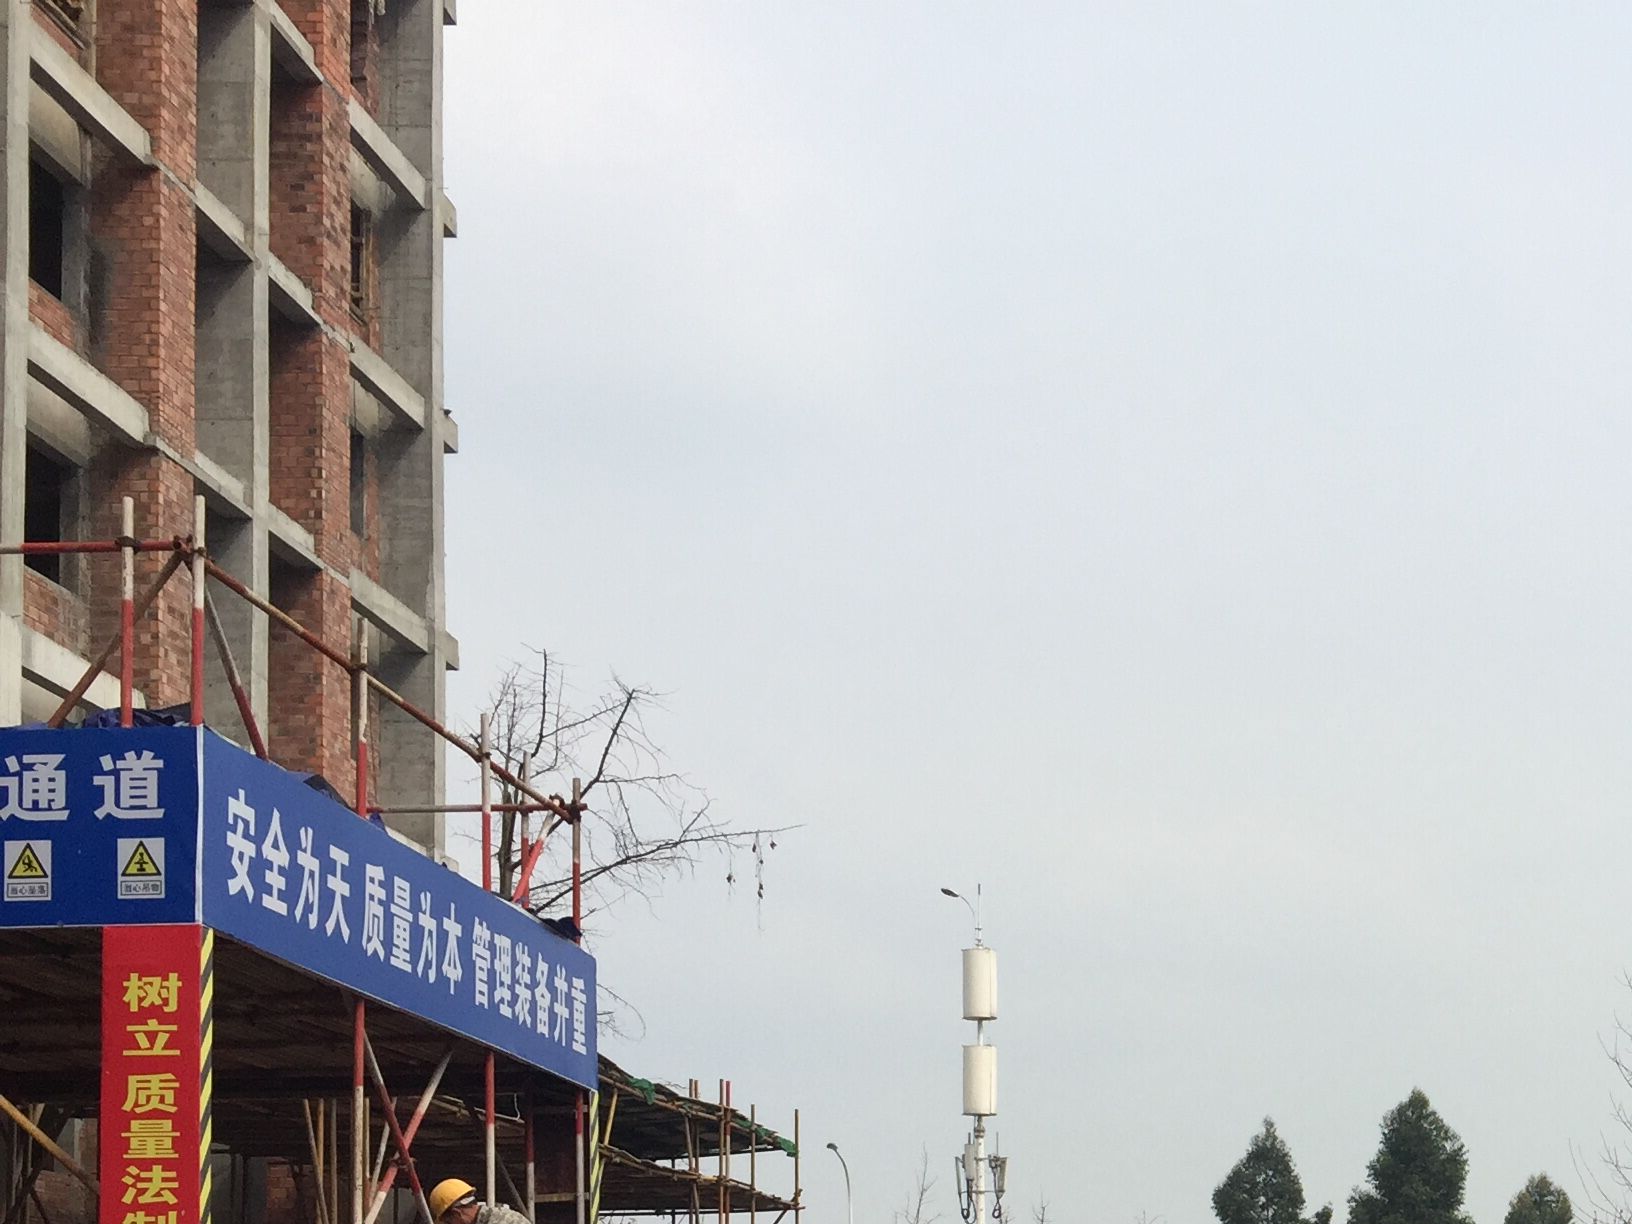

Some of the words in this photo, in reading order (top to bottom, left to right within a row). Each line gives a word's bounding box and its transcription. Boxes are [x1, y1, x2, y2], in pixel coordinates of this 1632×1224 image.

[0, 750, 166, 821] 通道
[226, 788, 350, 945] 安全为天
[362, 863, 463, 995] 质量为本
[472, 916, 588, 1056] 管理装备并重
